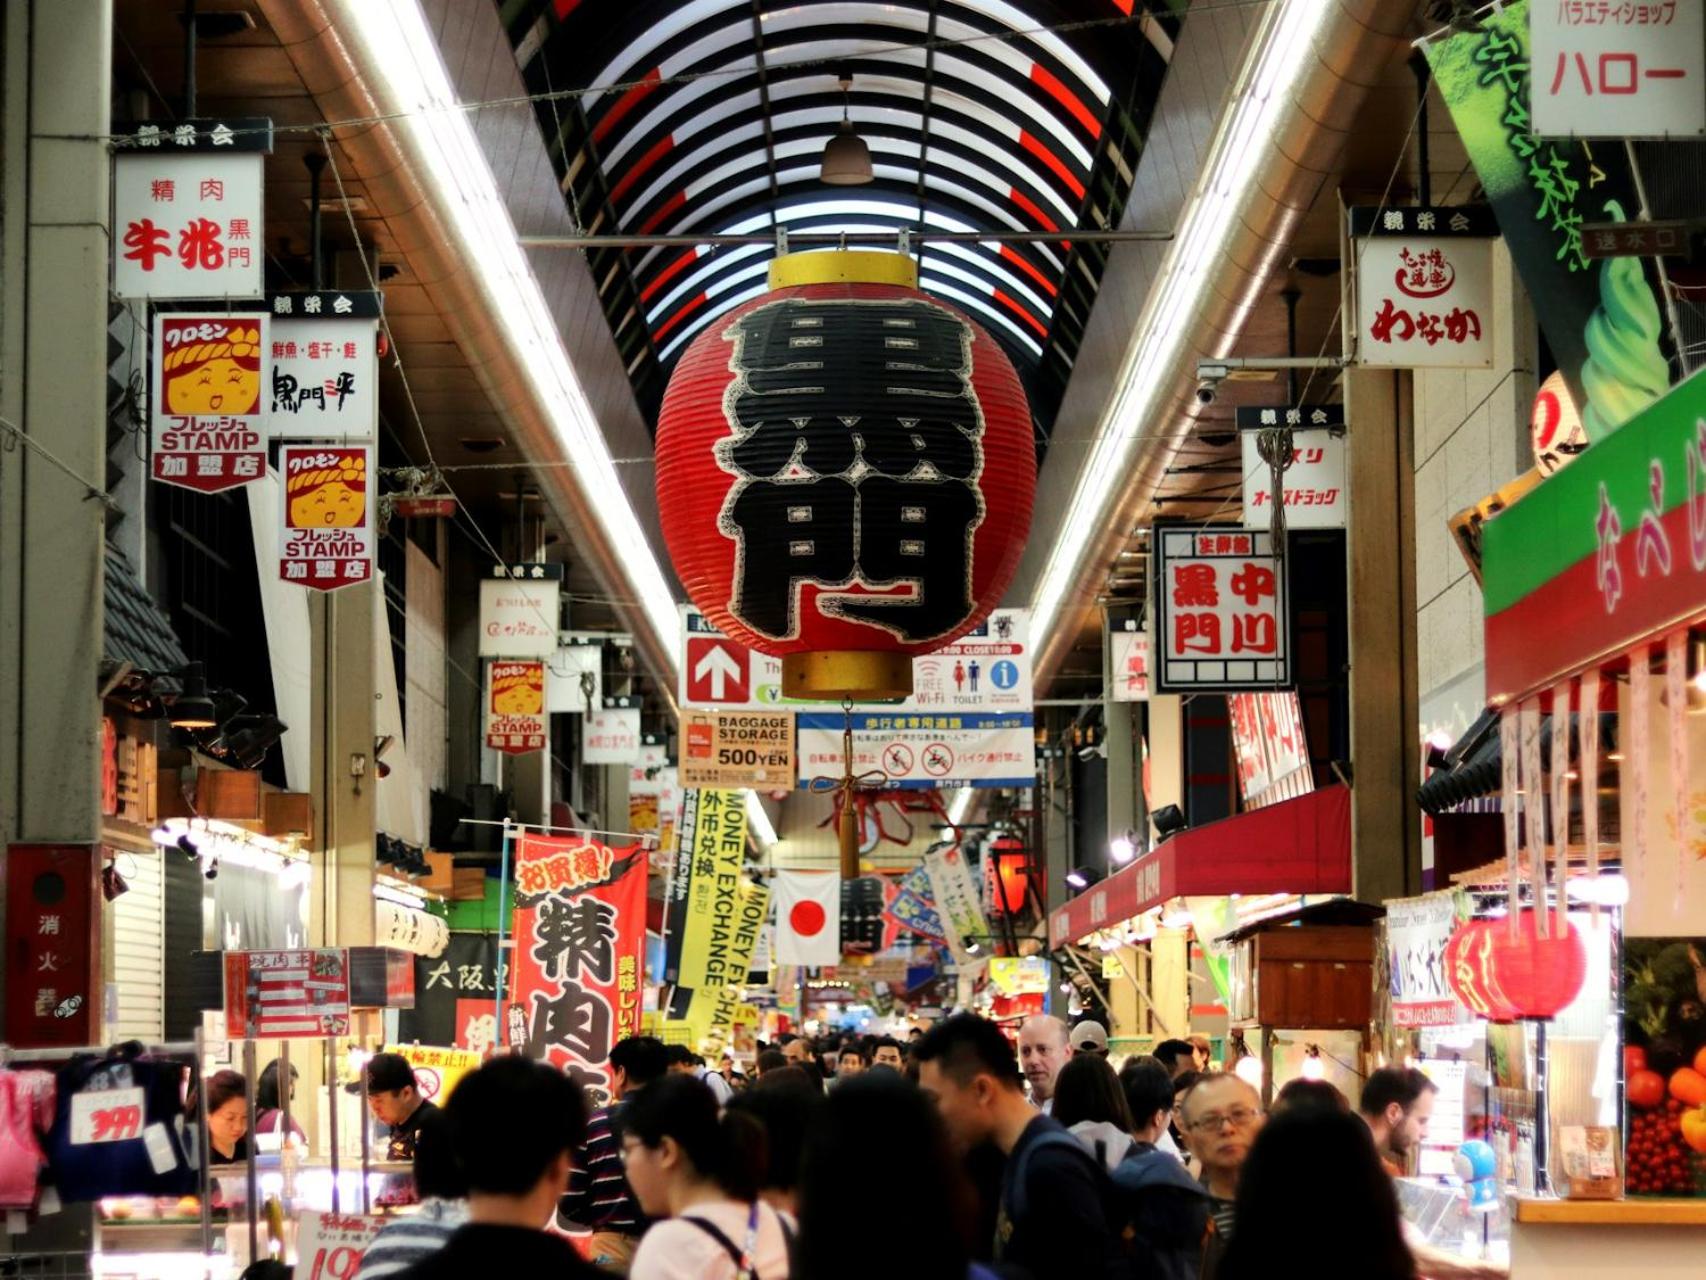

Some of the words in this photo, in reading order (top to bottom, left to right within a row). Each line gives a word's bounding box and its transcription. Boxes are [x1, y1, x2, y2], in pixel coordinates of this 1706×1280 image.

[1550, 52, 1686, 96] ハロー
[151, 178, 224, 202] 精肉
[123, 217, 225, 272] 牛兆
[228, 218, 250, 269] 黒門
[1370, 299, 1482, 346] わなか
[165, 322, 229, 348] クロモン
[169, 416, 249, 432] フレッシュ
[161, 431, 260, 451] STAMP
[161, 454, 260, 477] 加盟店
[288, 453, 340, 471] クロモン
[1252, 487, 1340, 508] オースドラッグ
[292, 528, 356, 542] フレッシュ
[286, 541, 366, 558] STAMP
[286, 561, 365, 579] 加盟店
[916, 678, 943, 690] FREE
[916, 692, 945, 704] Wi-Fi
[953, 695, 983, 704] TOILET
[491, 723, 542, 734] STAMP
[719, 717, 788, 728] BAGGAGE
[719, 729, 788, 740] STORAGE
[719, 749, 757, 766] 500
[759, 755, 788, 766] YEN
[720, 793, 745, 867] MONEY
[705, 873, 737, 988] EXCHANGE
[732, 889, 767, 960] MONEY
